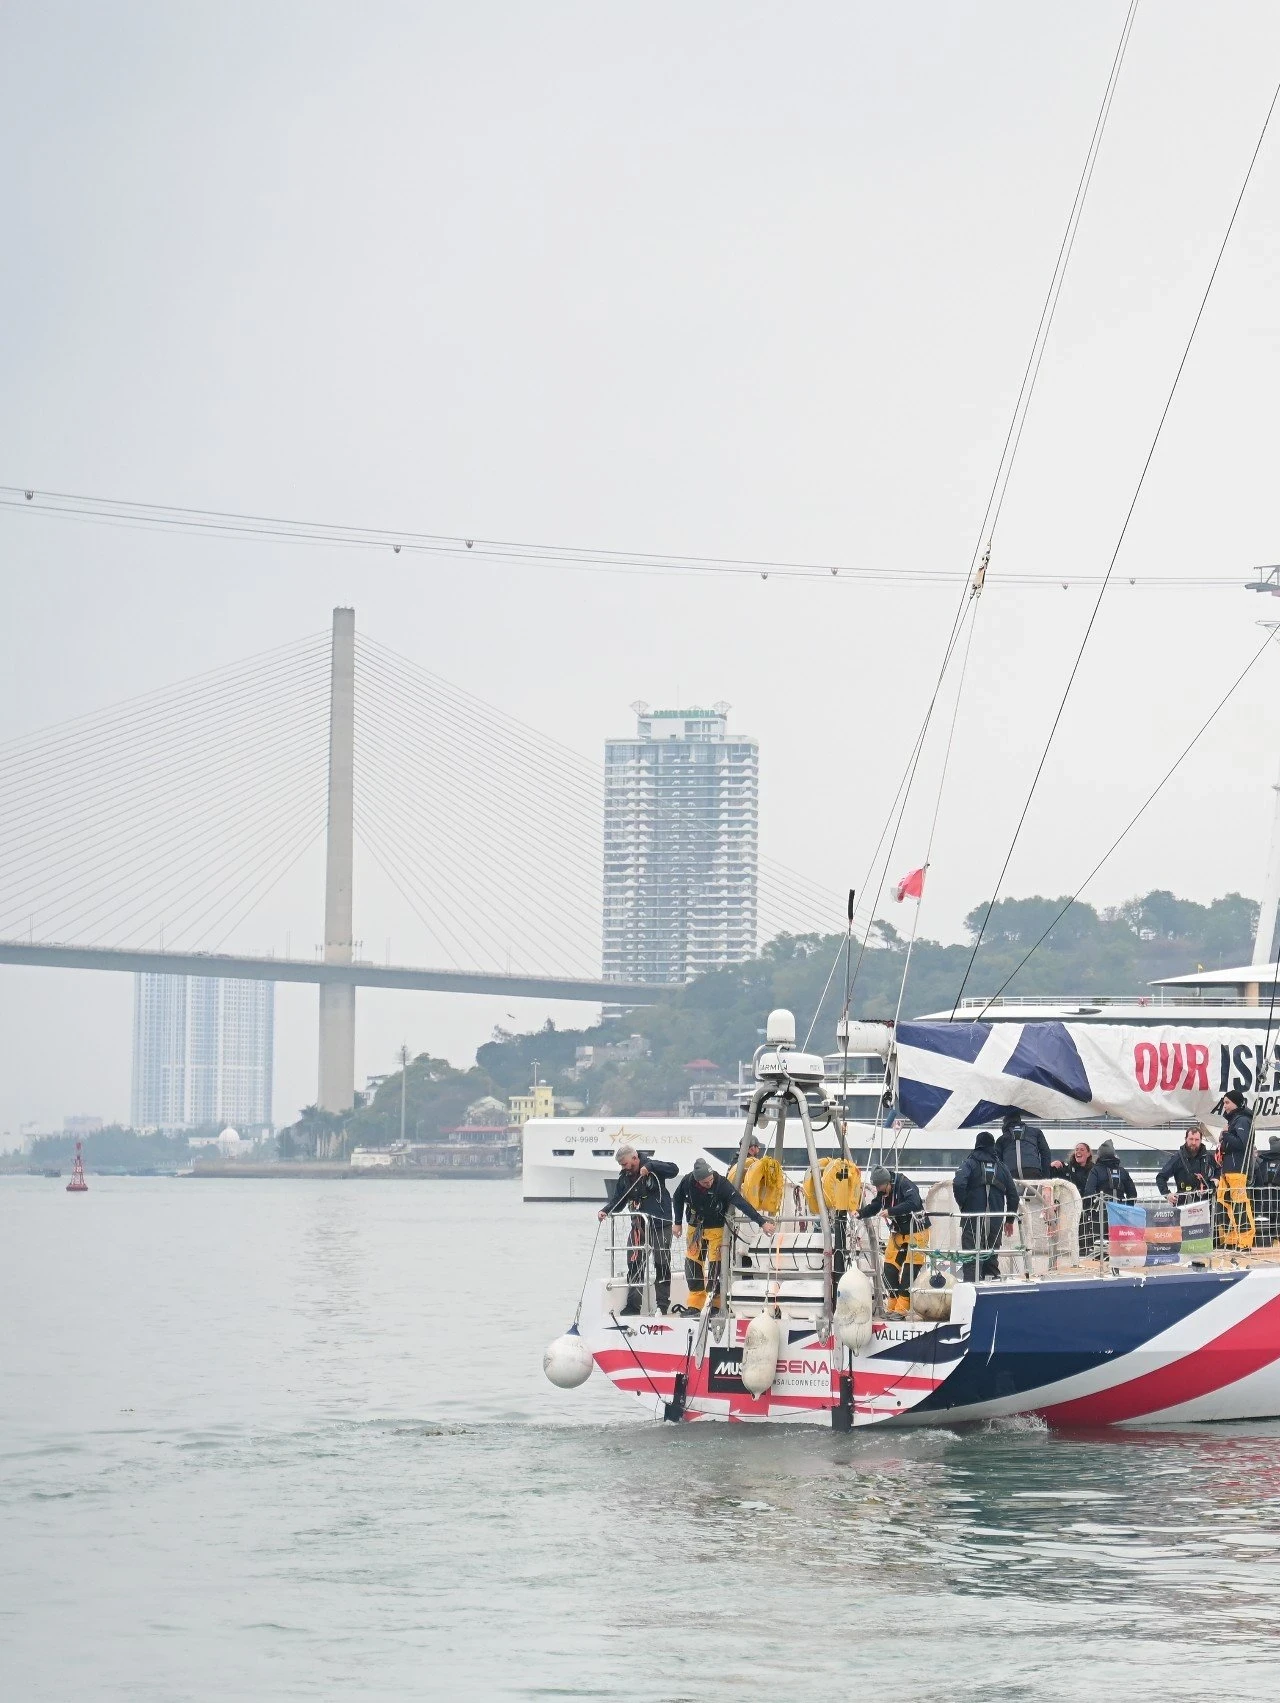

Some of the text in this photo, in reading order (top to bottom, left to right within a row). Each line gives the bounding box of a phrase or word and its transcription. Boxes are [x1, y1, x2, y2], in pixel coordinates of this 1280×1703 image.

[1133, 1042, 1210, 1093] OUR
[564, 1135, 599, 1143] QN-9989
[639, 1135, 694, 1144] SEA STARS
[640, 1324, 663, 1335] CV21
[875, 1329, 928, 1340] VALLETT
[776, 1359, 830, 1374] SENA
